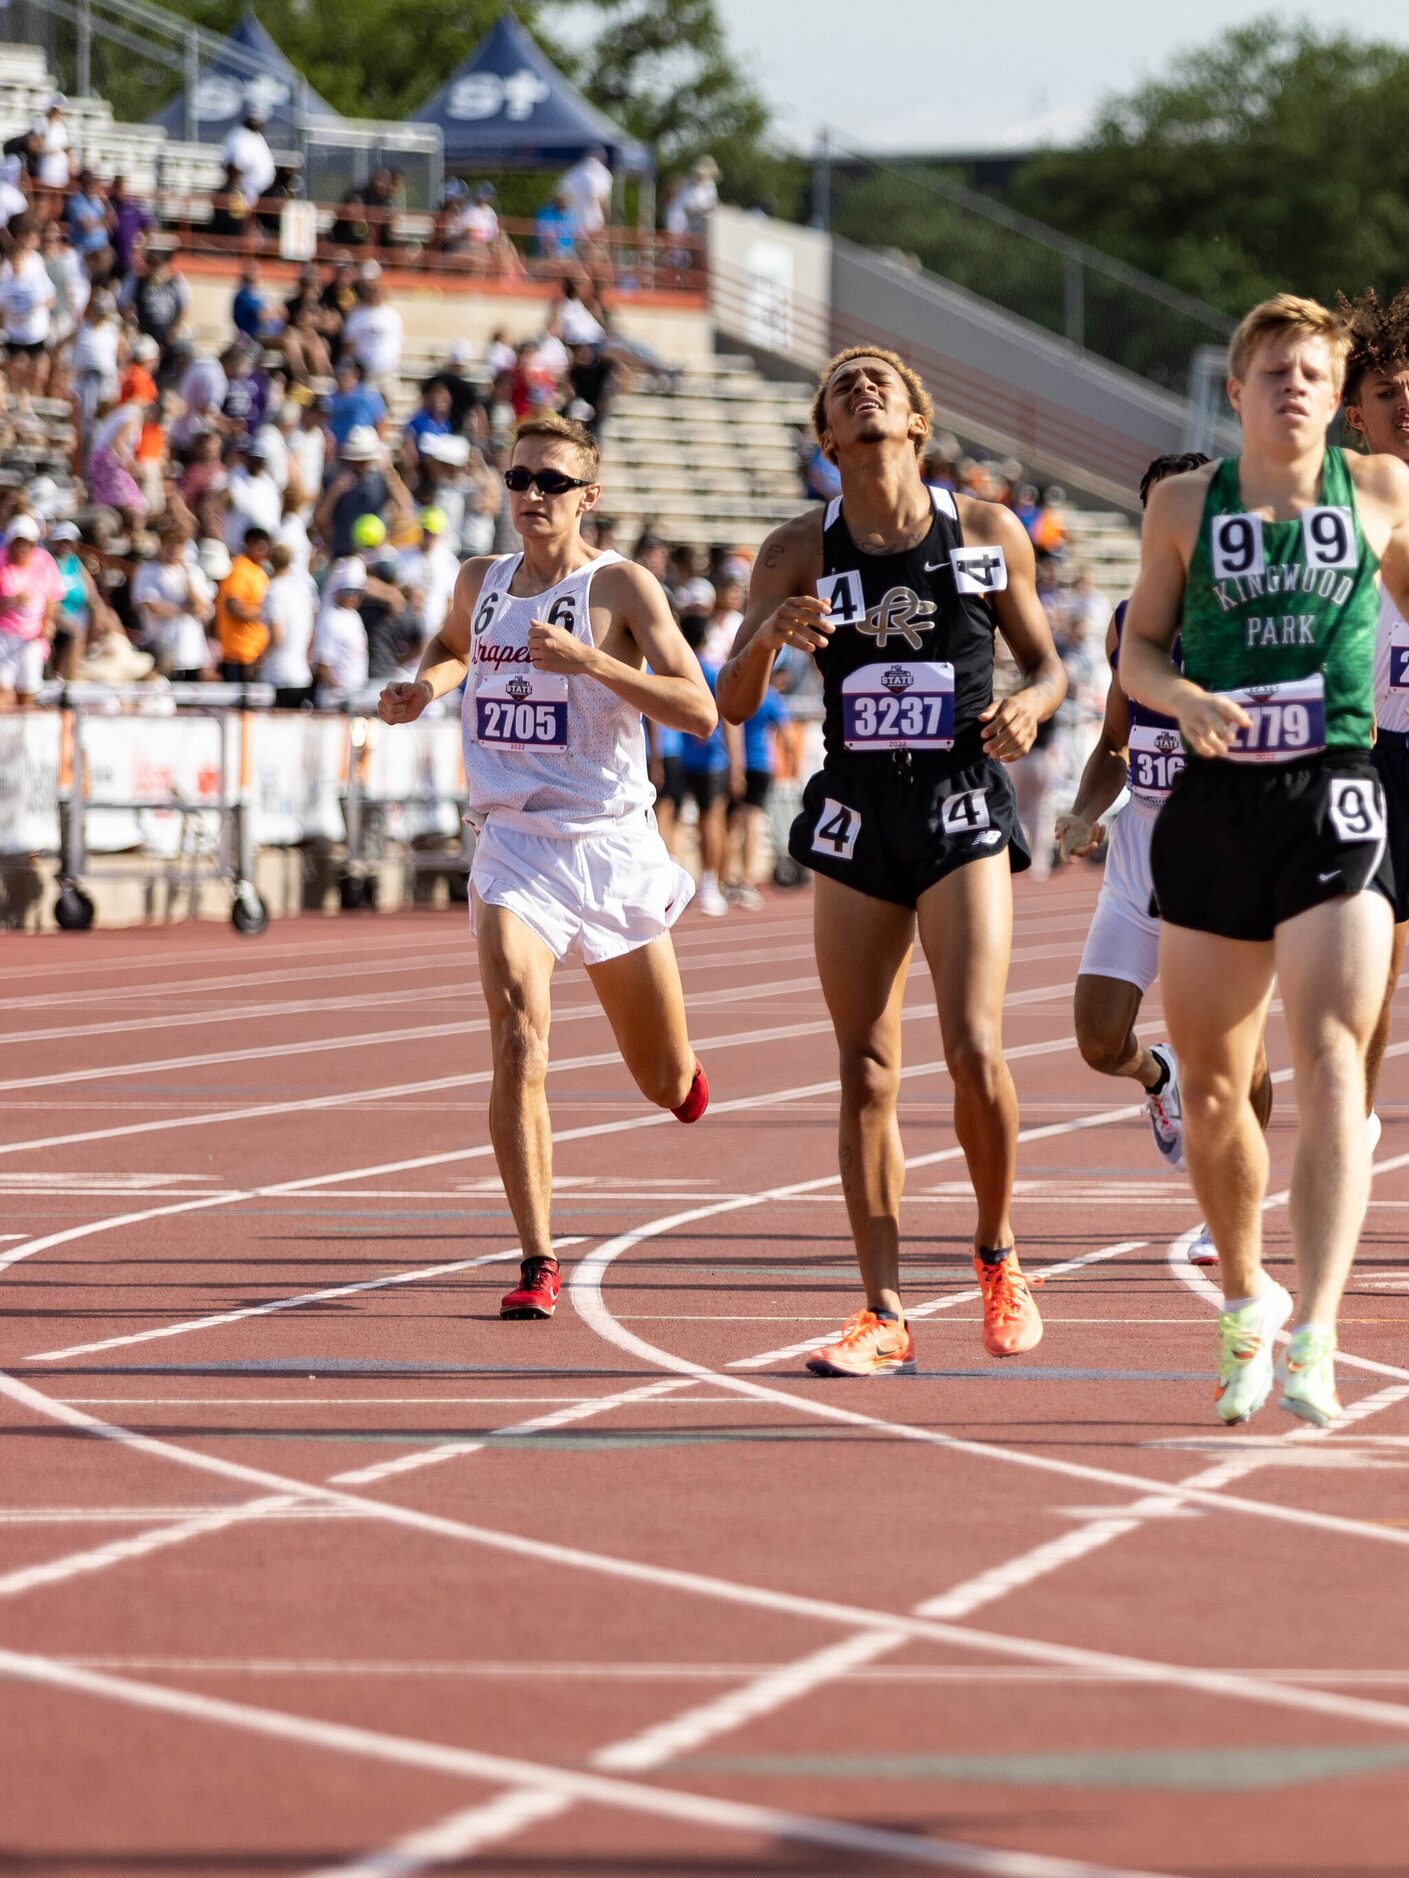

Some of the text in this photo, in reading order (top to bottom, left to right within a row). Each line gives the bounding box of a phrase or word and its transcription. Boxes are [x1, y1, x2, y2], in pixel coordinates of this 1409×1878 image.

[1219, 518, 1255, 572] 9
[1311, 511, 1348, 563] 9
[957, 554, 1001, 586] 4
[1212, 563, 1354, 613] KINGWOOD
[474, 592, 499, 636] 6
[547, 596, 576, 635] 6
[825, 576, 857, 621] 4
[1247, 614, 1316, 646] PARK
[506, 684, 532, 694] STATE
[881, 677, 914, 685] STATE
[484, 701, 556, 741] 2705
[854, 696, 943, 736] 3237
[1154, 739, 1179, 748] STATE
[819, 805, 852, 853] 4
[948, 792, 980, 826] 4
[1338, 786, 1373, 834] 9
